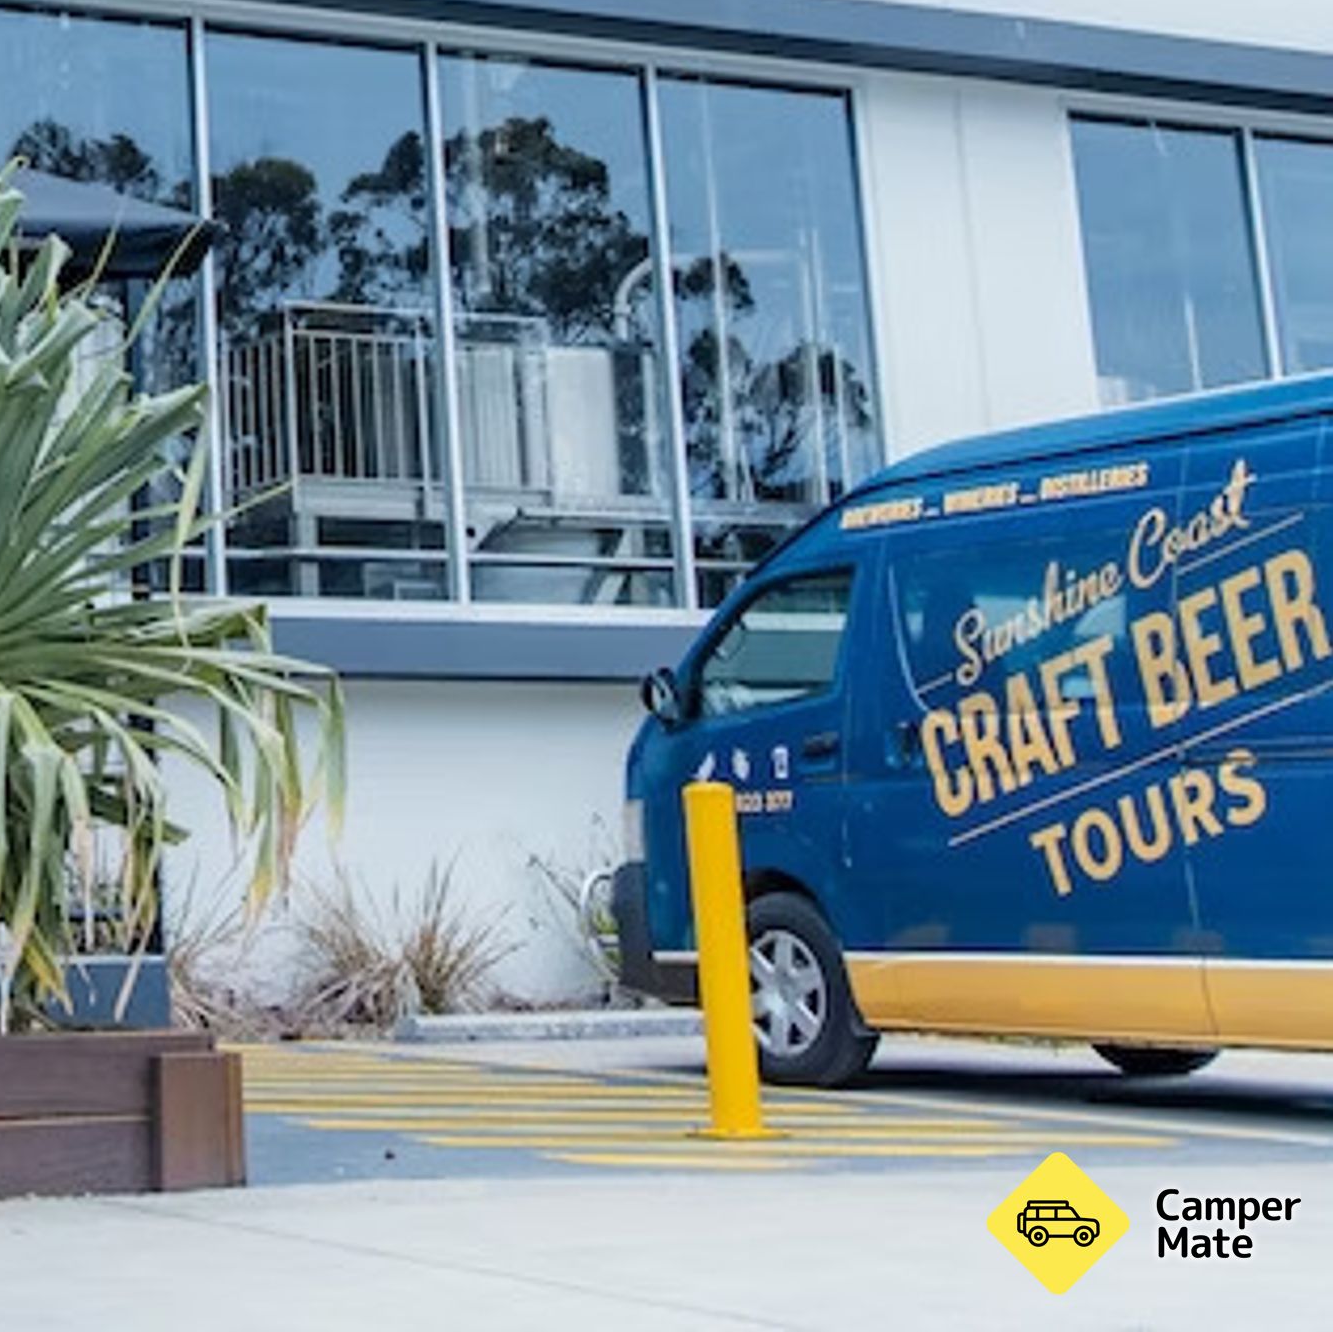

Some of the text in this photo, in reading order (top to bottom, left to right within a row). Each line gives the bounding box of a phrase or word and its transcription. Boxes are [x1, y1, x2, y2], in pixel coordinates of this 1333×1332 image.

[921, 549, 1333, 817] CRAFT BEER
[955, 459, 1257, 686] Sunshine Coast
[1030, 748, 1268, 896] TOURS
